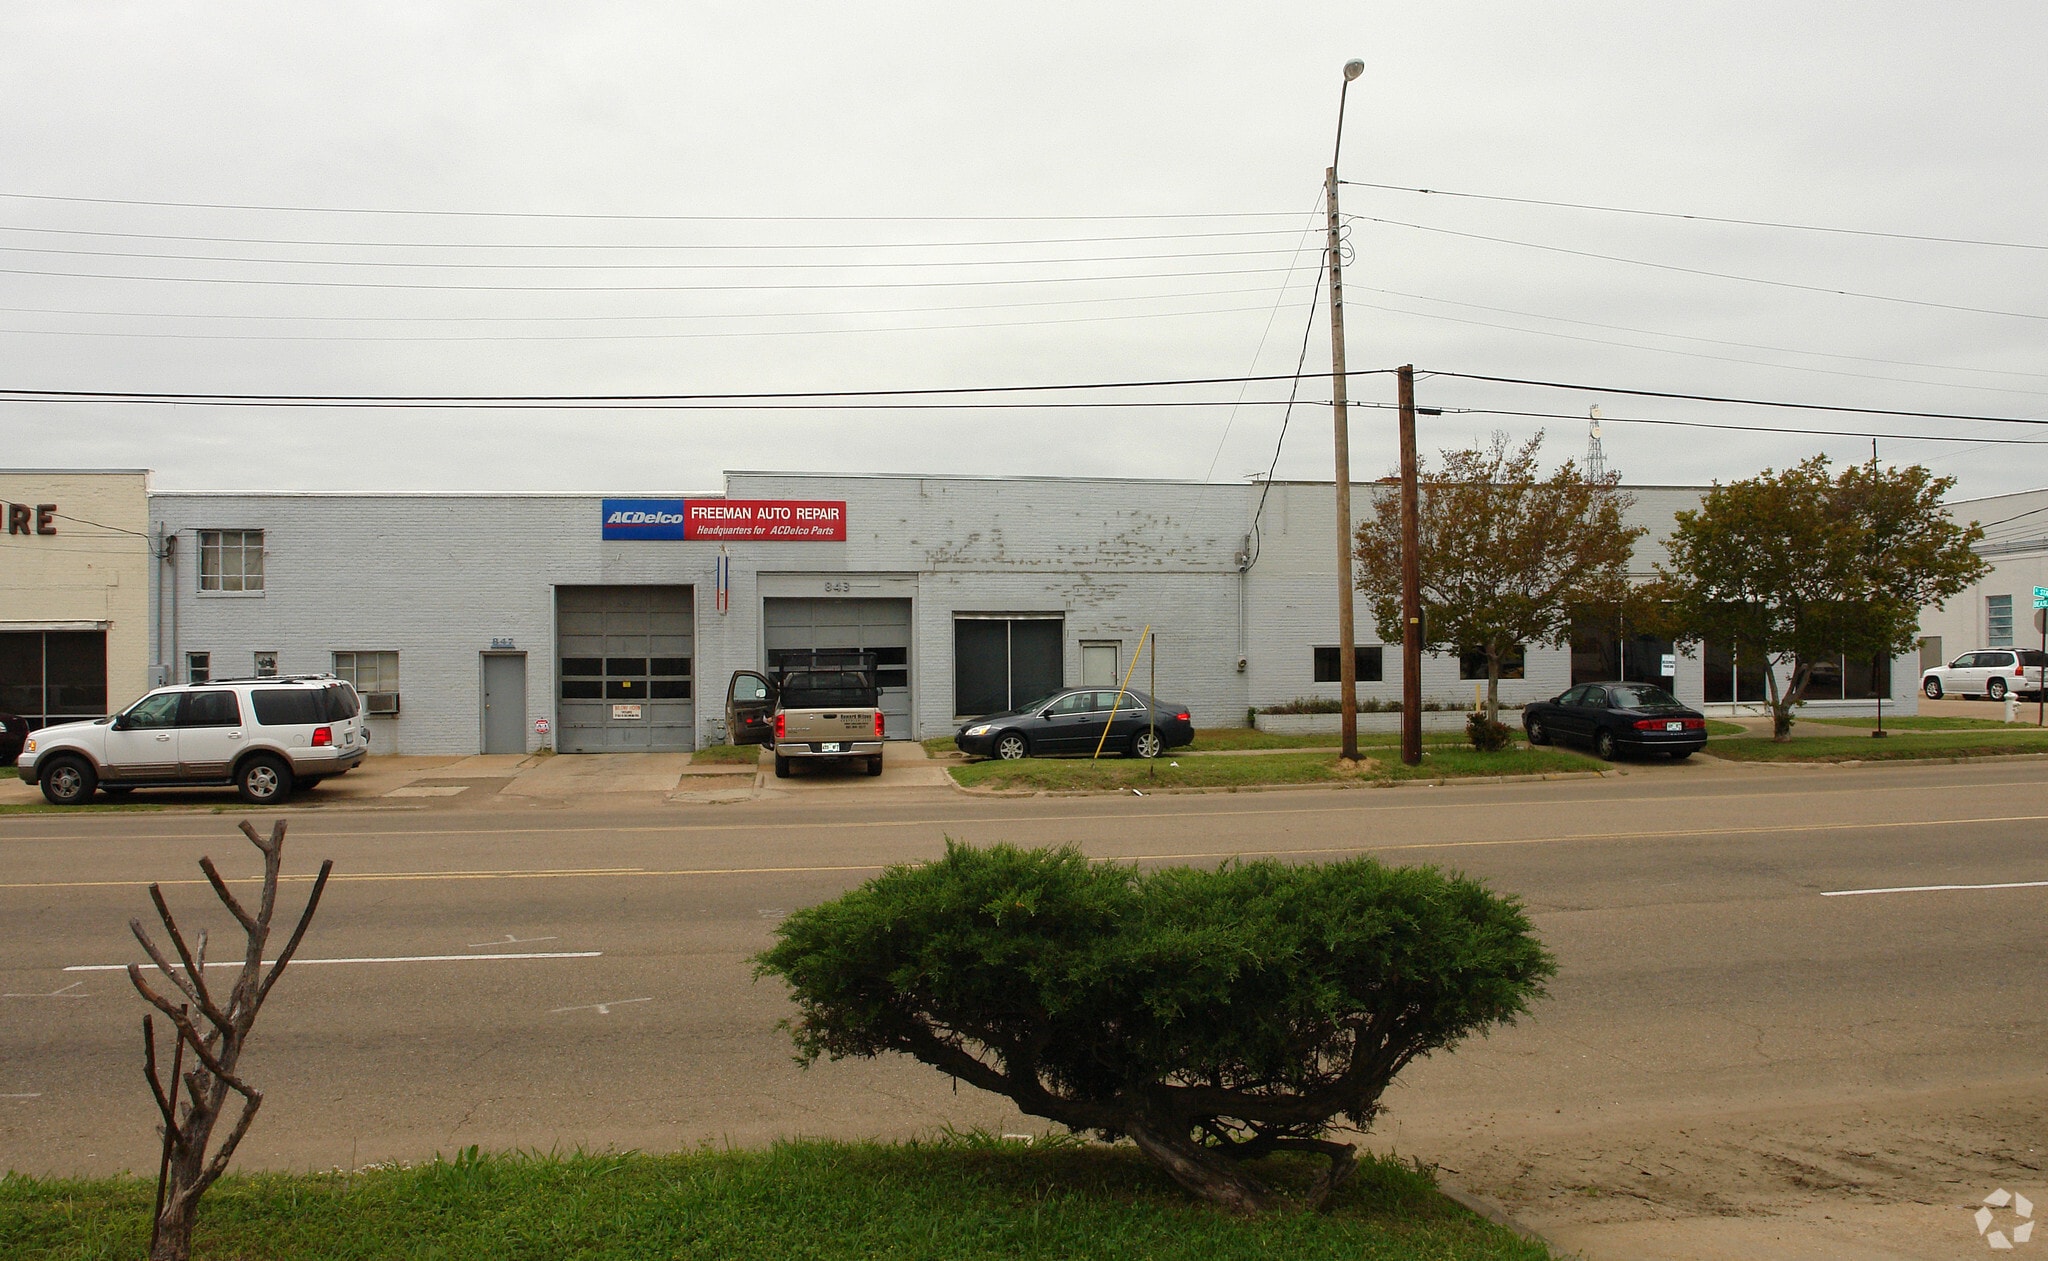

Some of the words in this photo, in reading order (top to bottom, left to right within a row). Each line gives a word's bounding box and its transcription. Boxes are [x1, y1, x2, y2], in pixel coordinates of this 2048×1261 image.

[0, 503, 57, 535] RE
[607, 511, 684, 524] ACDelco
[691, 507, 751, 519] FREEMAN
[757, 507, 791, 519] AUTO
[796, 508, 840, 520] REPAIR
[696, 525, 752, 537] Headquarters
[753, 526, 766, 535] for
[770, 526, 809, 535] ACDelco
[810, 526, 834, 535] Parts
[825, 582, 850, 592] 843
[492, 637, 514, 646] 847
